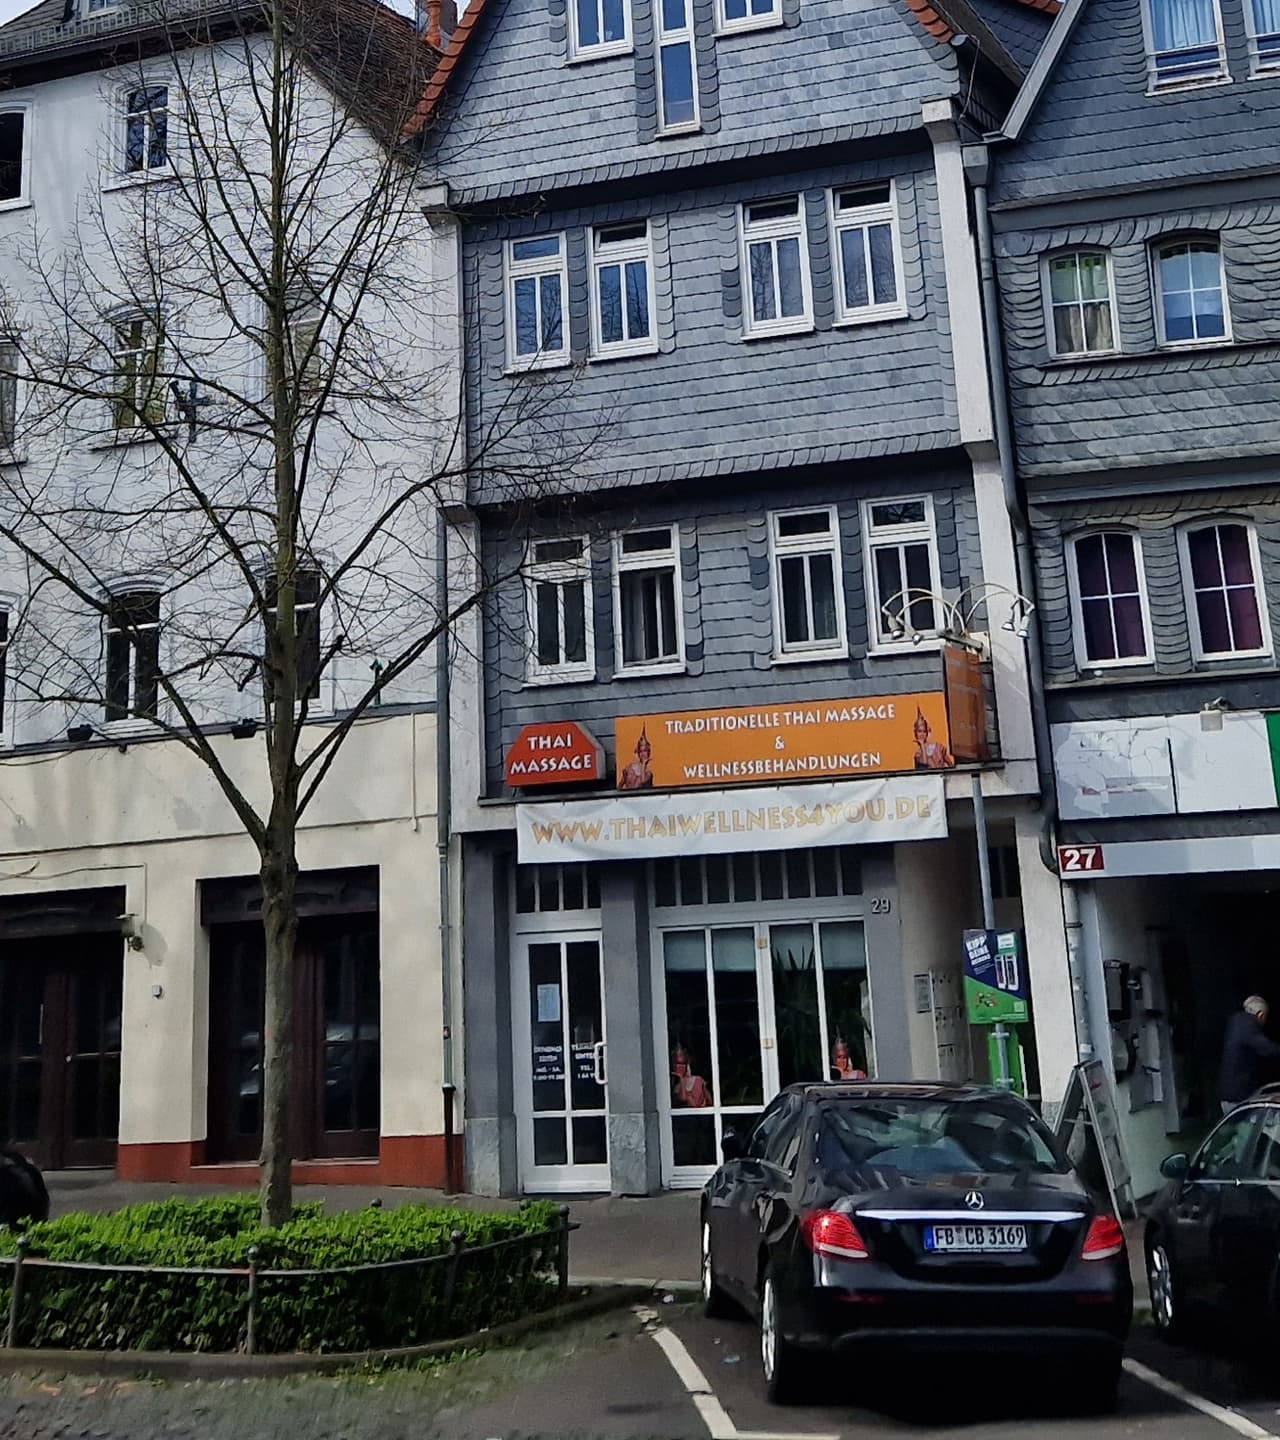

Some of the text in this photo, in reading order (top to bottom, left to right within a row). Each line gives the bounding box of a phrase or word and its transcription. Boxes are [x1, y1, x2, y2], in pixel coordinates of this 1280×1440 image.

[665, 703, 895, 734] TRADITIONELLE THAI MASSAGE
[528, 733, 572, 751] THAI
[774, 735, 785, 750] &
[510, 754, 593, 775] MASSAGE
[683, 752, 881, 778] WELLNESSBEHANDLUNGEN
[531, 795, 931, 845] WWW.THAIWELLNESS4YOU.DE
[1064, 848, 1096, 870] 27
[872, 898, 890, 913] 29
[935, 1227, 1024, 1246] FB CB 3169
